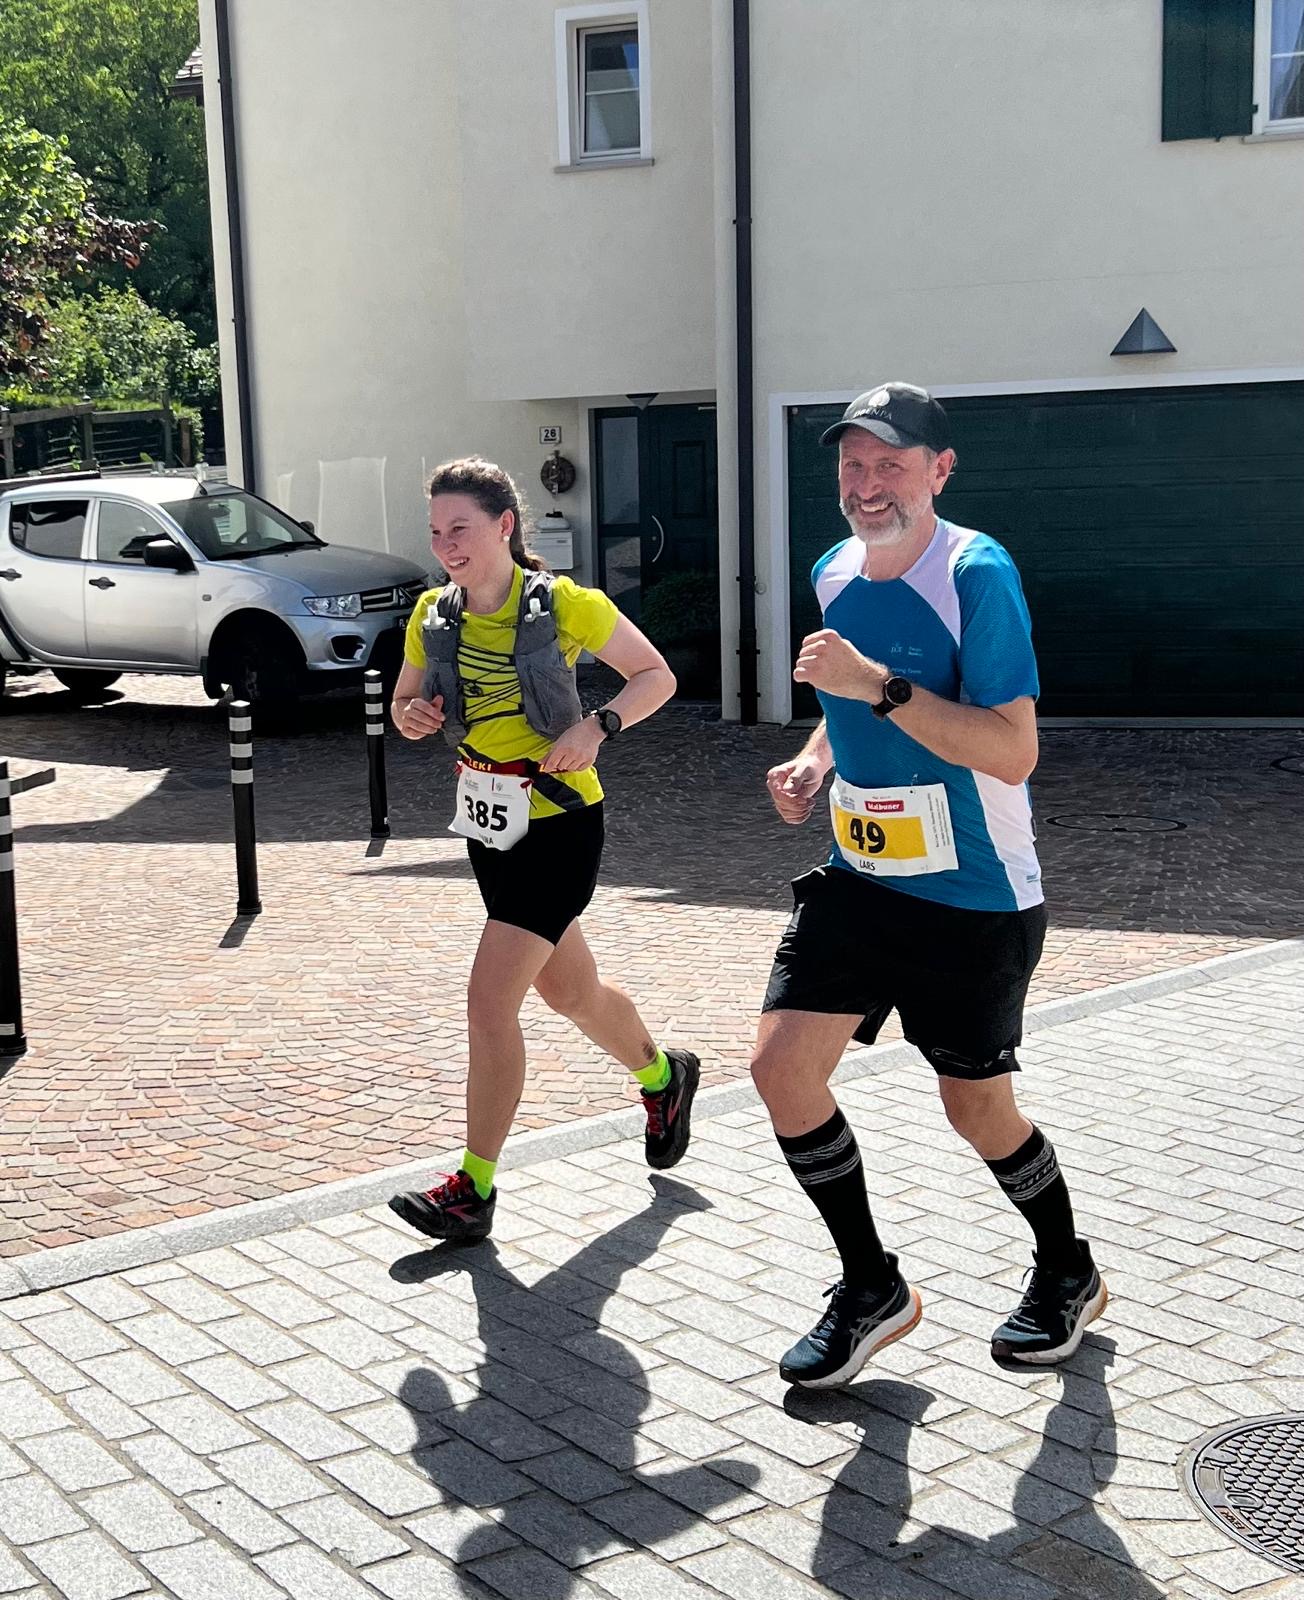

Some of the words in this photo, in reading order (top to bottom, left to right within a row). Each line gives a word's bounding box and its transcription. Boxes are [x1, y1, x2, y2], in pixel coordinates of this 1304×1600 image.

[468, 759, 492, 772] LEKI
[464, 795, 508, 831] 385
[850, 817, 886, 854] 49
[859, 859, 876, 871] LARS
